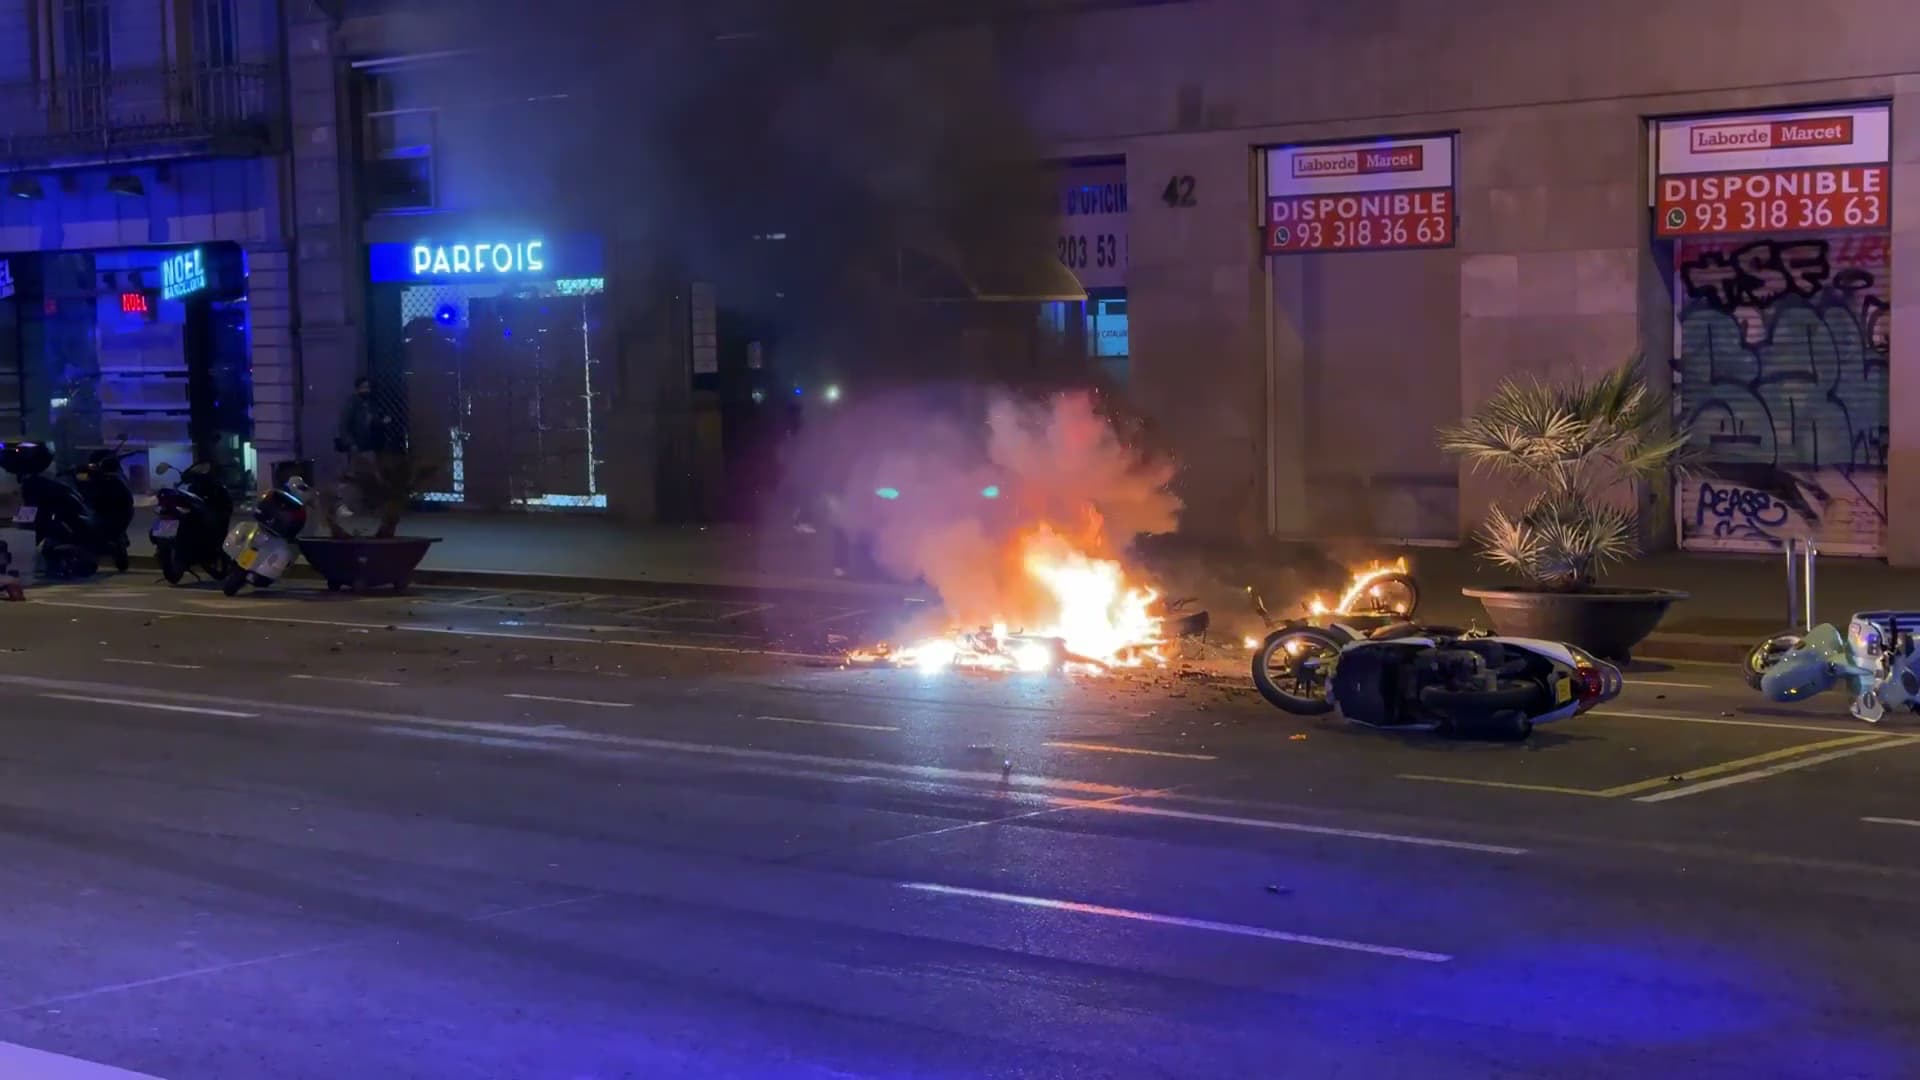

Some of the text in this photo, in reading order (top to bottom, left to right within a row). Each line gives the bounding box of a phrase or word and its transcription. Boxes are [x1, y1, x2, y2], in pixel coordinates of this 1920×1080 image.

[1698, 124, 1842, 147] Laborde Marcet
[1298, 152, 1414, 172] Laborde Marcet
[1162, 175, 1198, 208] 42
[1664, 169, 1881, 202] DISPONIBLE
[1272, 192, 1446, 222] DISPONIBLE
[1695, 195, 1879, 231] 93 318 36 63
[1296, 216, 1445, 247] 93 318 36 63
[414, 241, 543, 274] PARFOIS
[1097, 233, 1117, 267] 53
[163, 249, 204, 289] NOEL
